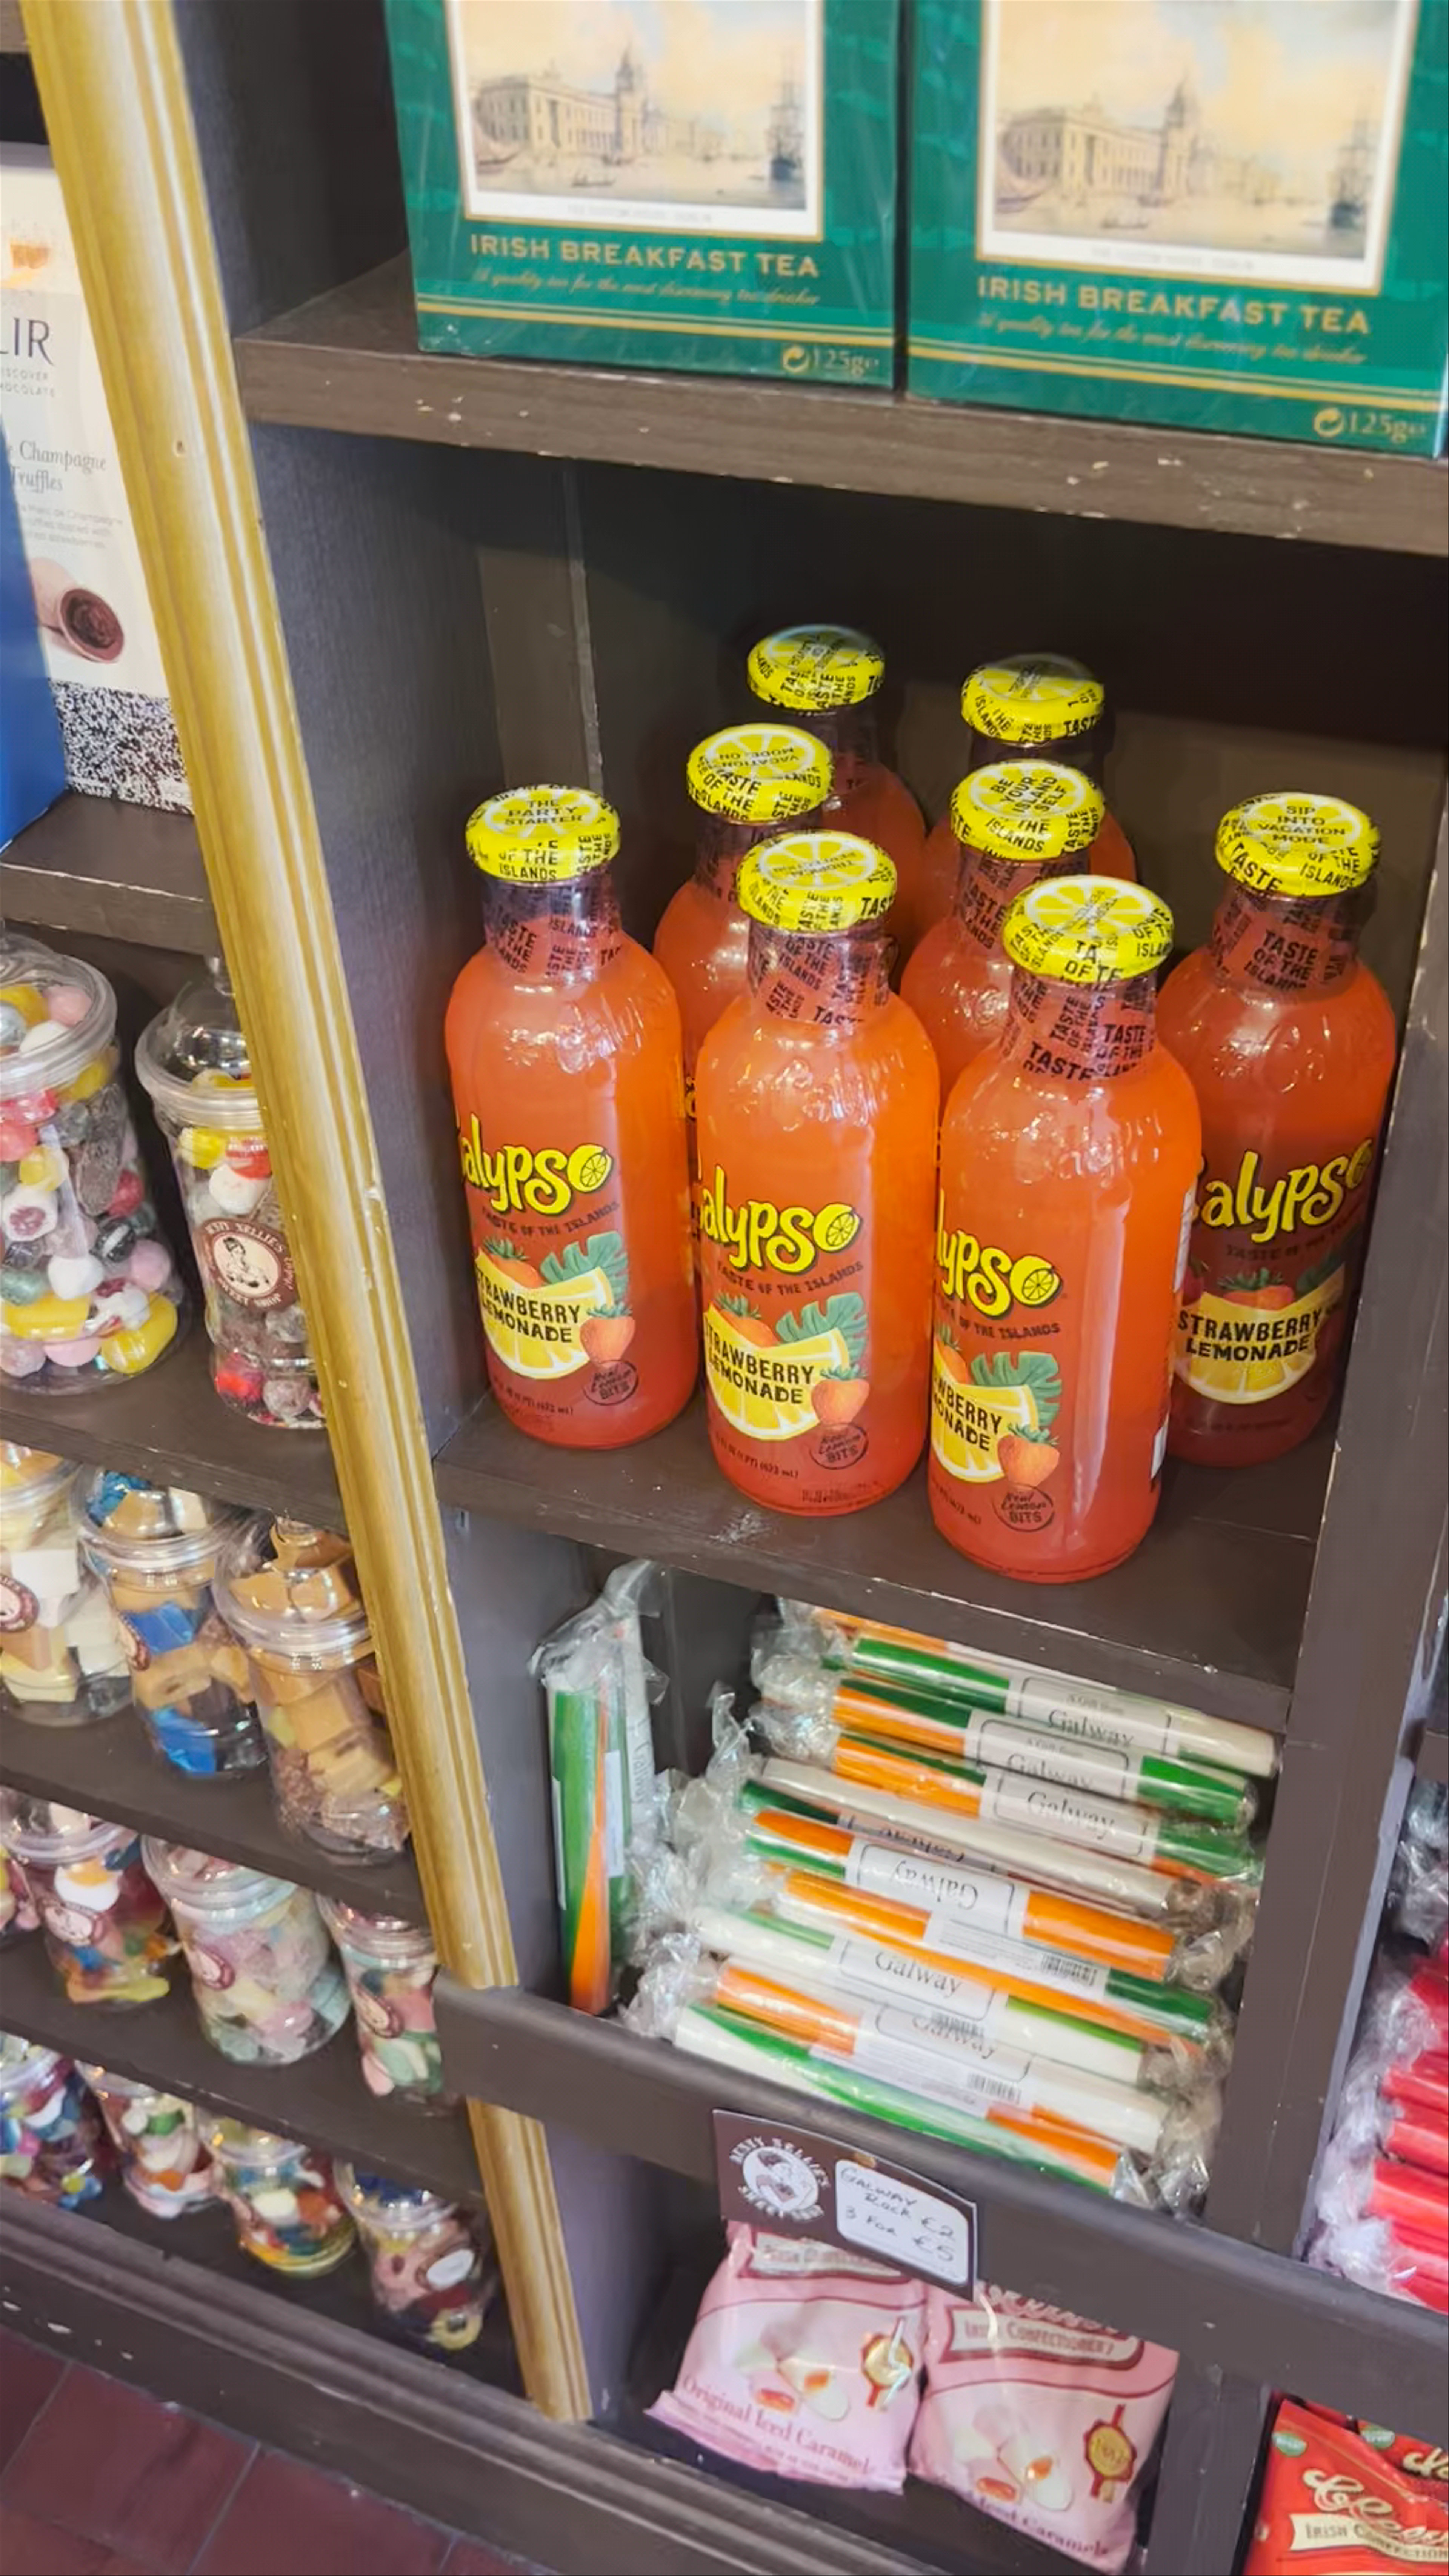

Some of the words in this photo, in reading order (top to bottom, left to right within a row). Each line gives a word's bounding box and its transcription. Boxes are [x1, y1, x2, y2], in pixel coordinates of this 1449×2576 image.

[471, 233, 551, 259] IRISH
[560, 240, 746, 274] BREAKFAST
[755, 252, 819, 278] TEA
[978, 276, 1067, 306] IRISH
[1077, 285, 1288, 327] BREAKFAST
[1301, 304, 1369, 335] TEA
[20, 440, 107, 475] Champagne
[10, 465, 63, 493] Truffles
[990, 777, 1014, 794] BE
[1001, 776, 1035, 803] YOUR
[1035, 785, 1067, 812] SELF
[504, 815, 583, 826] STARTER
[508, 807, 578, 817] PARTY
[1277, 816, 1326, 826] INTO
[1286, 806, 1317, 815] SIP
[986, 817, 1045, 852] ISLANDS
[1258, 823, 1346, 835] VACATION
[1272, 835, 1330, 844] MODE
[498, 863, 558, 880] ISLANDS
[1231, 841, 1283, 891] TASTE
[1299, 863, 1356, 889] ISLANDS
[1253, 948, 1275, 967] OF
[1281, 960, 1314, 980] THE
[1263, 929, 1319, 965] TASTE
[779, 953, 822, 991] ISLANDS
[1049, 995, 1078, 1041] TASTE
[1104, 1023, 1147, 1045] TASTE
[1028, 1041, 1094, 1082] TASTE
[460, 1112, 613, 1216] alypso
[1201, 1139, 1374, 1244] alypso
[563, 1201, 620, 1232] ISLANDS
[700, 1164, 861, 1273] alypso
[936, 1189, 1061, 1317] lypso
[777, 1283, 801, 1295] THE
[806, 1261, 864, 1292] ISLANDS
[481, 1293, 573, 1343] LEMONADE
[997, 1321, 1061, 1340] ISLANDS
[1178, 1308, 1322, 1341] STRAWBERRY
[1185, 1335, 1310, 1362] LEMONADE
[708, 1346, 803, 1404] LEMONADE
[936, 1376, 1003, 1435] WBERRY
[1009, 1510, 1043, 1524] BITS
[1048, 1709, 1134, 1748] Galway
[1007, 1753, 1094, 1790] Galway
[1027, 1791, 1117, 1841] Galway
[890, 1859, 979, 1911] Galway
[875, 1950, 963, 1999] Galway
[841, 2167, 918, 2206] GALWAY
[846, 2206, 856, 2220] 3
[682, 2375, 752, 2422] Original
[755, 2408, 792, 2441] Iced
[1305, 2523, 1348, 2539] IRISH
